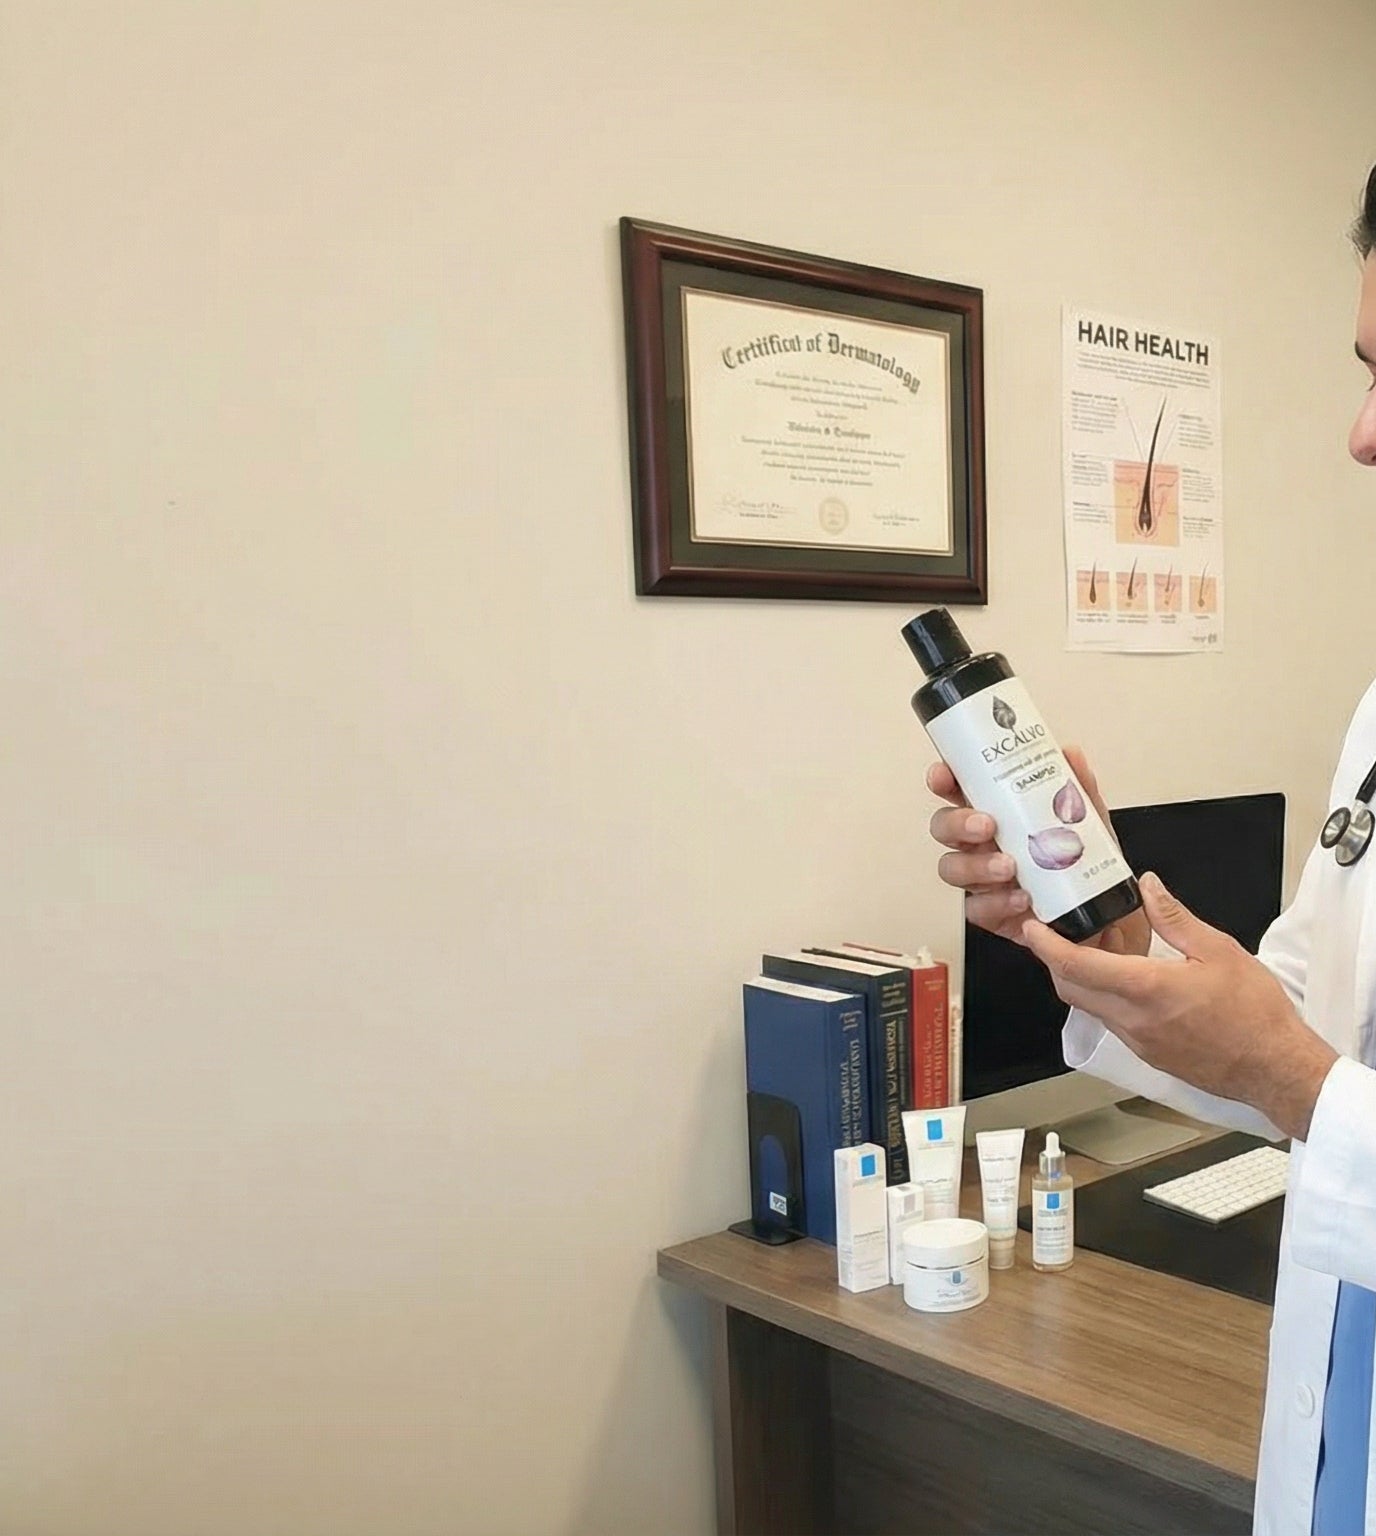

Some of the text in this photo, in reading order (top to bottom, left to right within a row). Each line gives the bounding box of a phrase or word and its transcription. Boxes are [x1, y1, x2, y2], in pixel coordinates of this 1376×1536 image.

[805, 332, 823, 353] of
[827, 332, 921, 395] Dermatology
[1077, 319, 1209, 366] HAIR HEALTH
[981, 723, 1046, 763] EXCALVO
